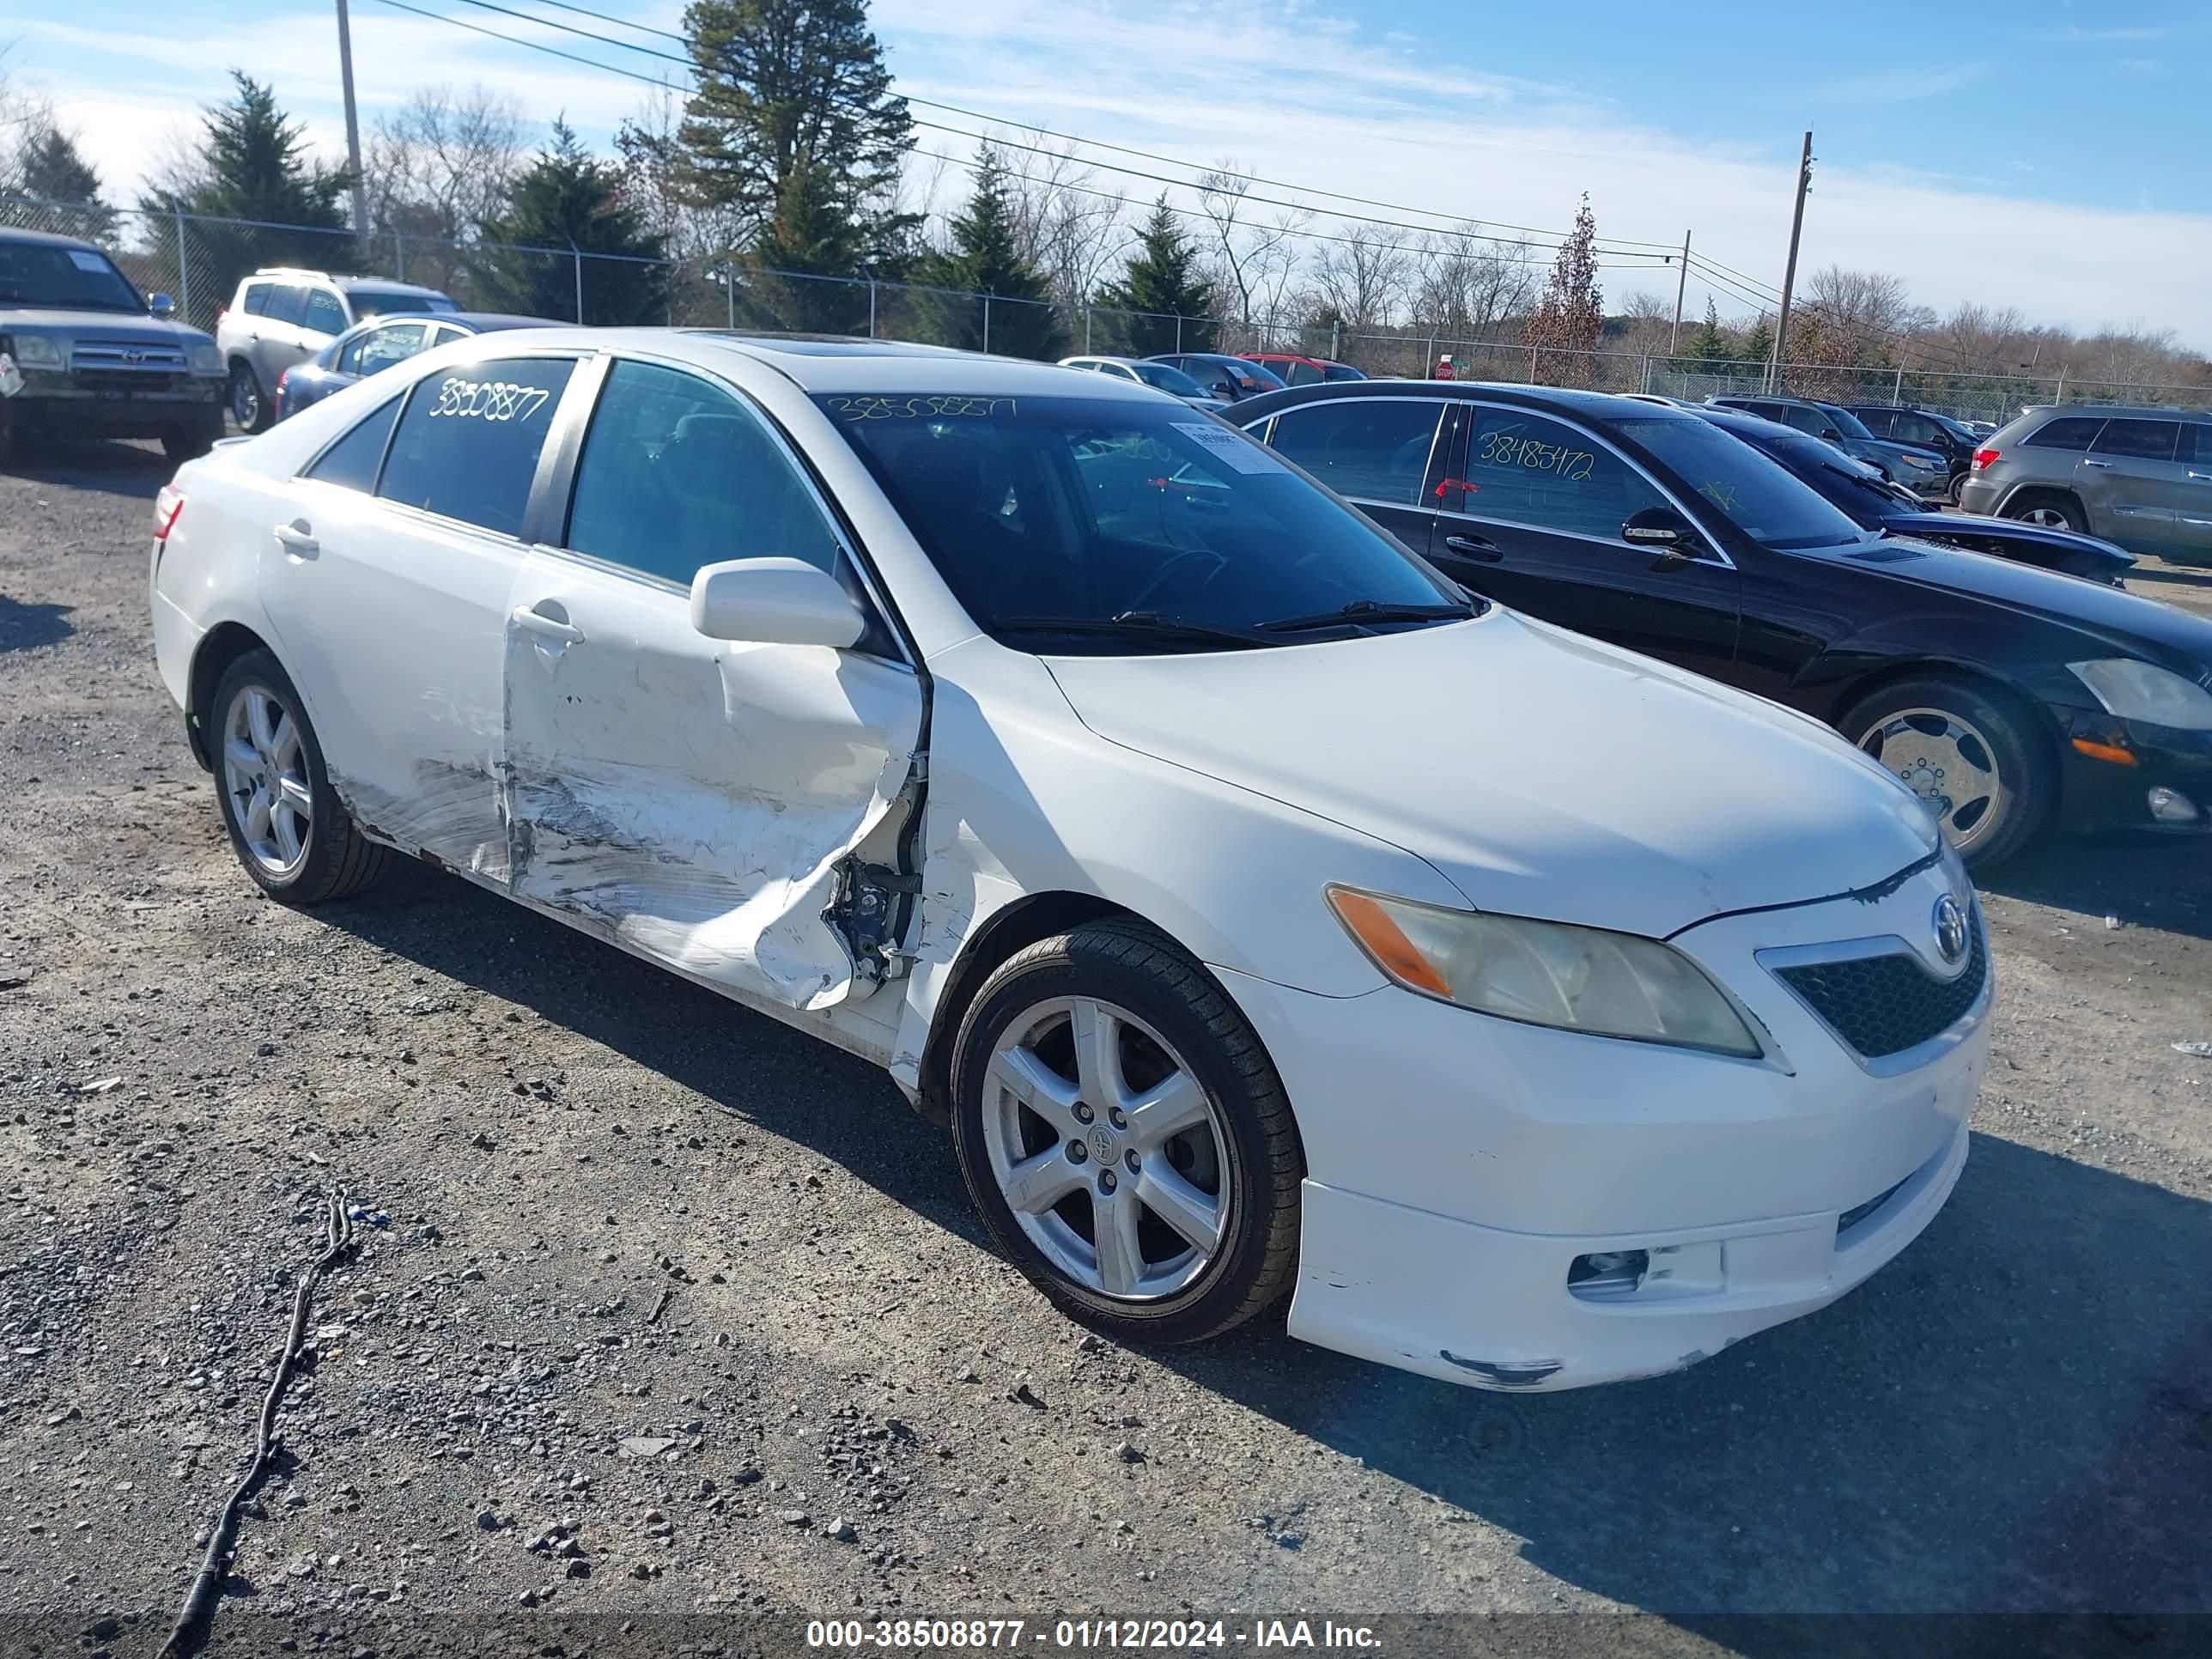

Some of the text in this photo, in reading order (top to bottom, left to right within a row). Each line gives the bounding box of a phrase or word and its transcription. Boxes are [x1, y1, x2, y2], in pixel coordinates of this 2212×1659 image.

[1437, 368, 1453, 378] STOP
[429, 377, 550, 423] 38508877
[827, 397, 1017, 422] 38508877
[1480, 431, 1595, 481] 38485472
